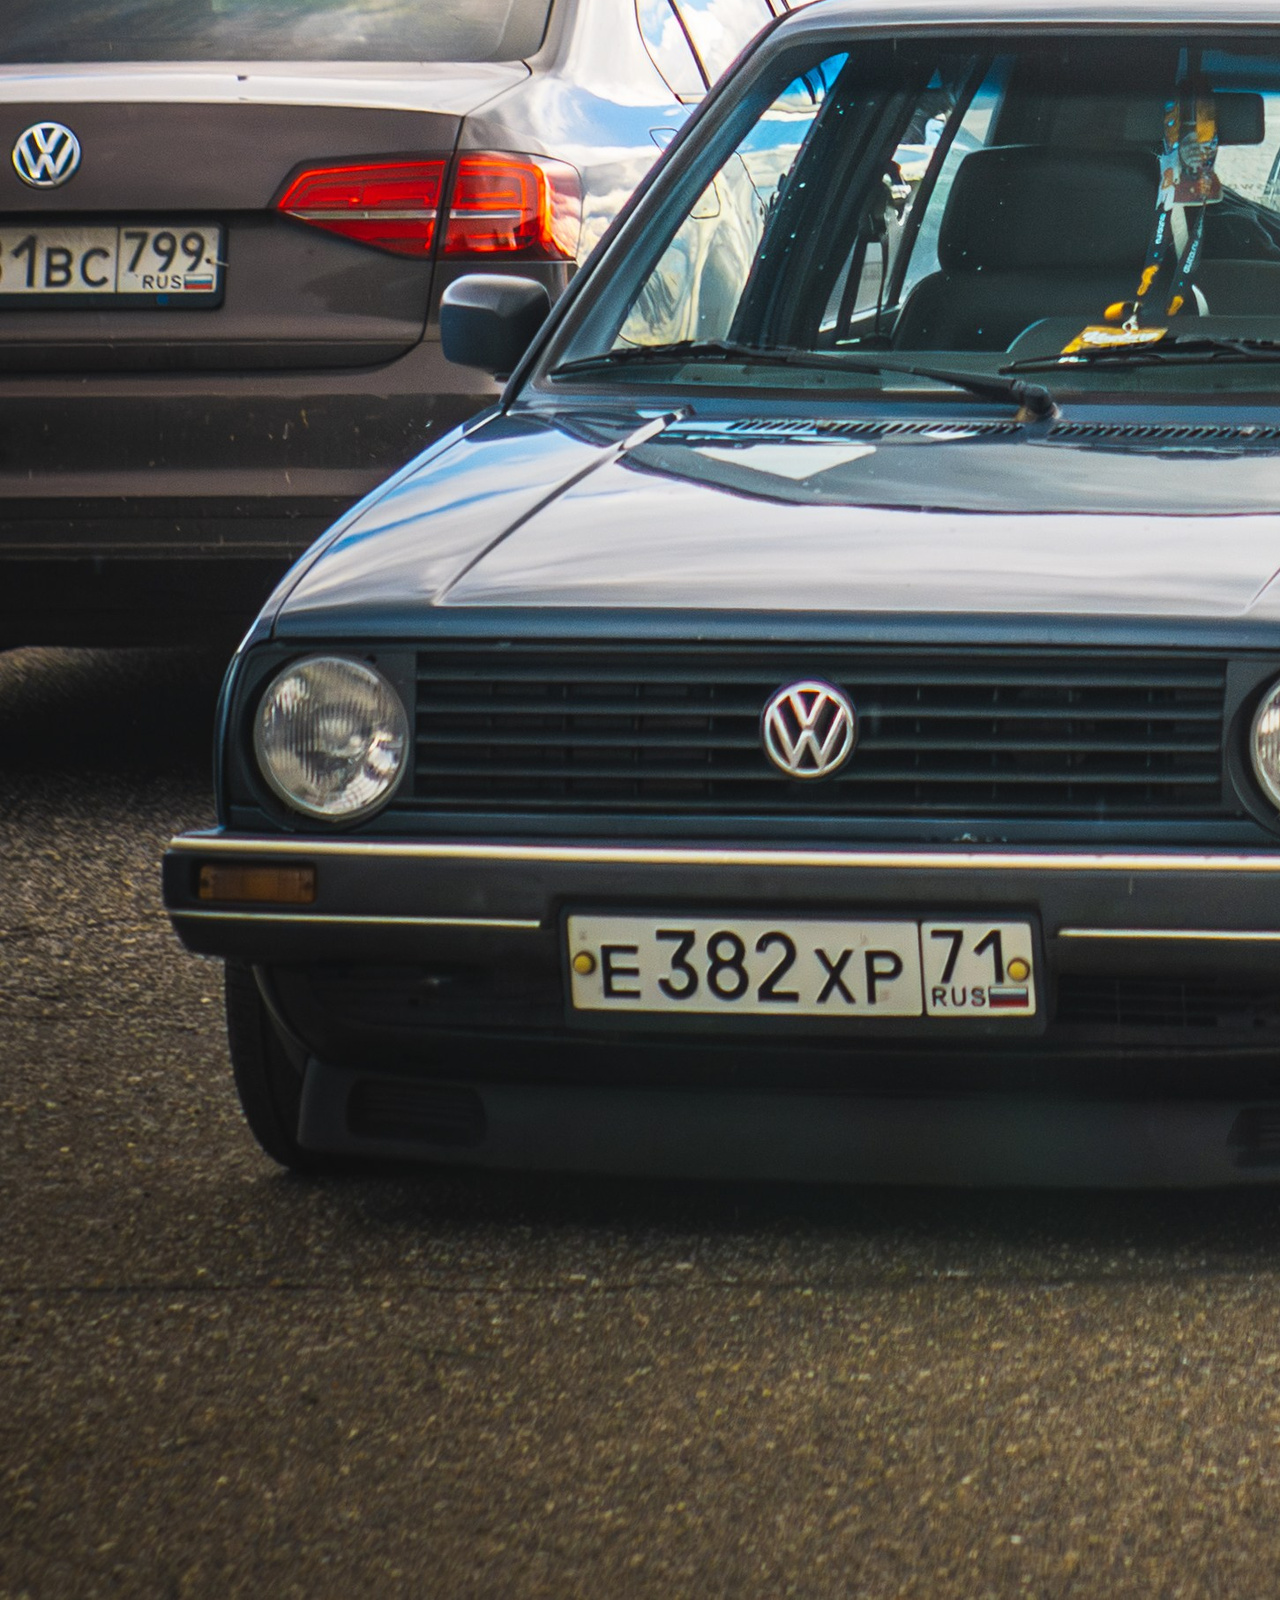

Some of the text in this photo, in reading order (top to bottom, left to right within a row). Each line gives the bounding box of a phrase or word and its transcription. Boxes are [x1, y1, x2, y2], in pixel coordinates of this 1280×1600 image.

[12, 121, 81, 187] VW
[0, 231, 206, 288] 1ВС 799
[142, 275, 182, 289] RUS
[763, 680, 855, 778] VW
[600, 929, 1004, 1005] Е382ХР 71
[931, 986, 987, 1008] RUS
